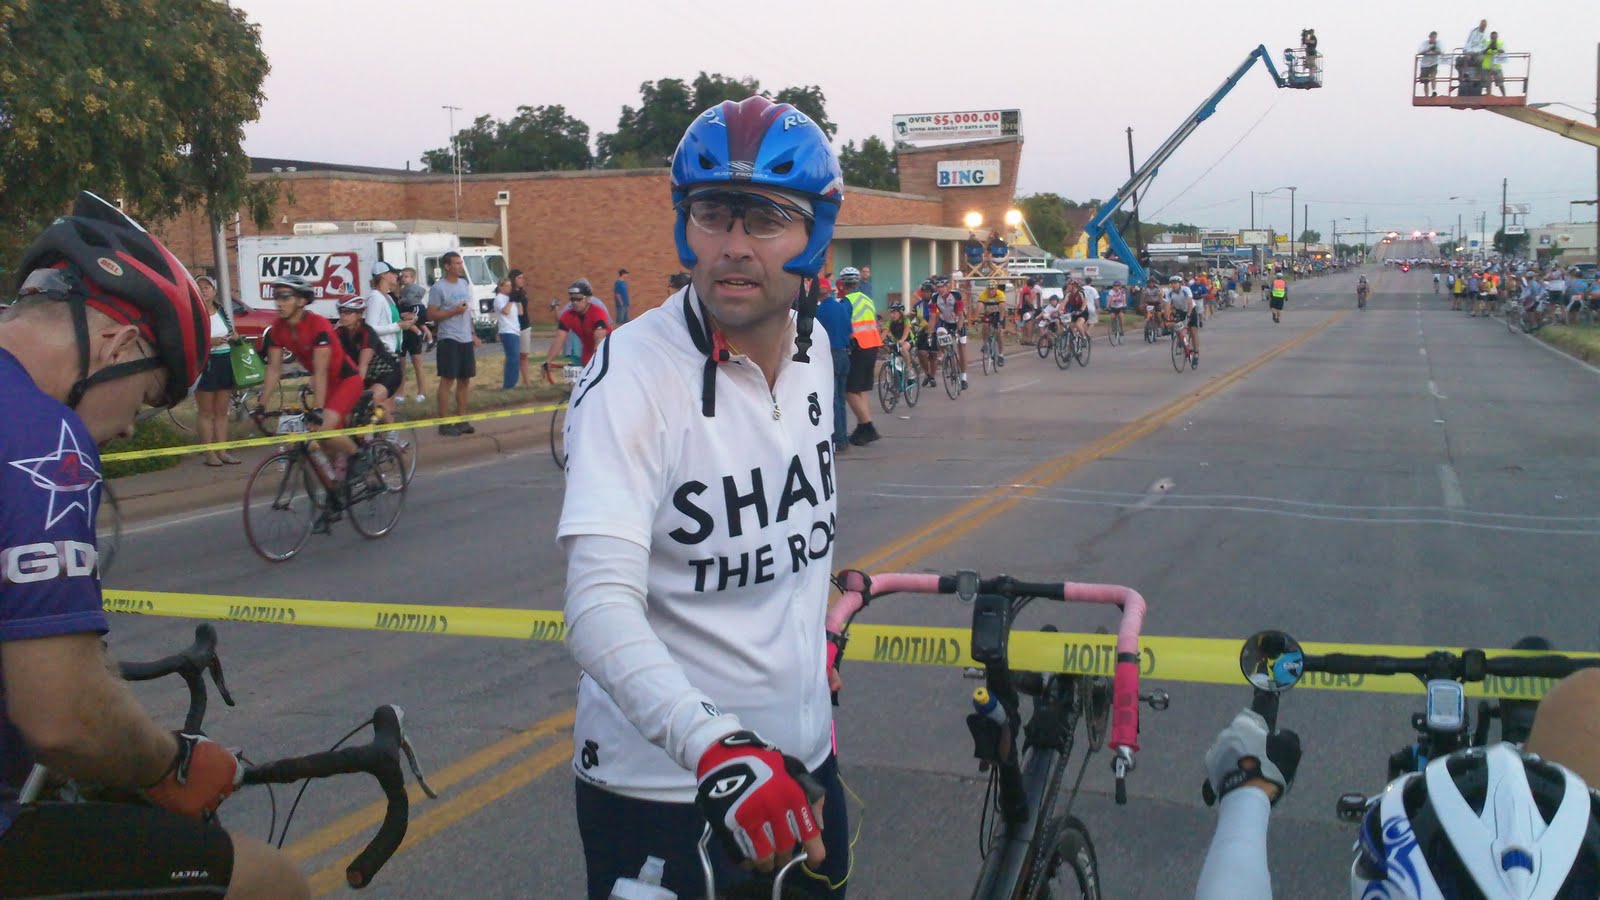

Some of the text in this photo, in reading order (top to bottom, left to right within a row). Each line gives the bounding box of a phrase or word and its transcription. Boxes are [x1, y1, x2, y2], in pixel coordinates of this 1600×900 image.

[934, 112, 999, 125] $5,000.00
[939, 170, 997, 185] BING
[262, 255, 320, 277] KFDX
[325, 255, 356, 296] 3
[669, 433, 836, 545] SHAR
[6, 541, 100, 584] GD
[688, 512, 836, 592] THE ROA
